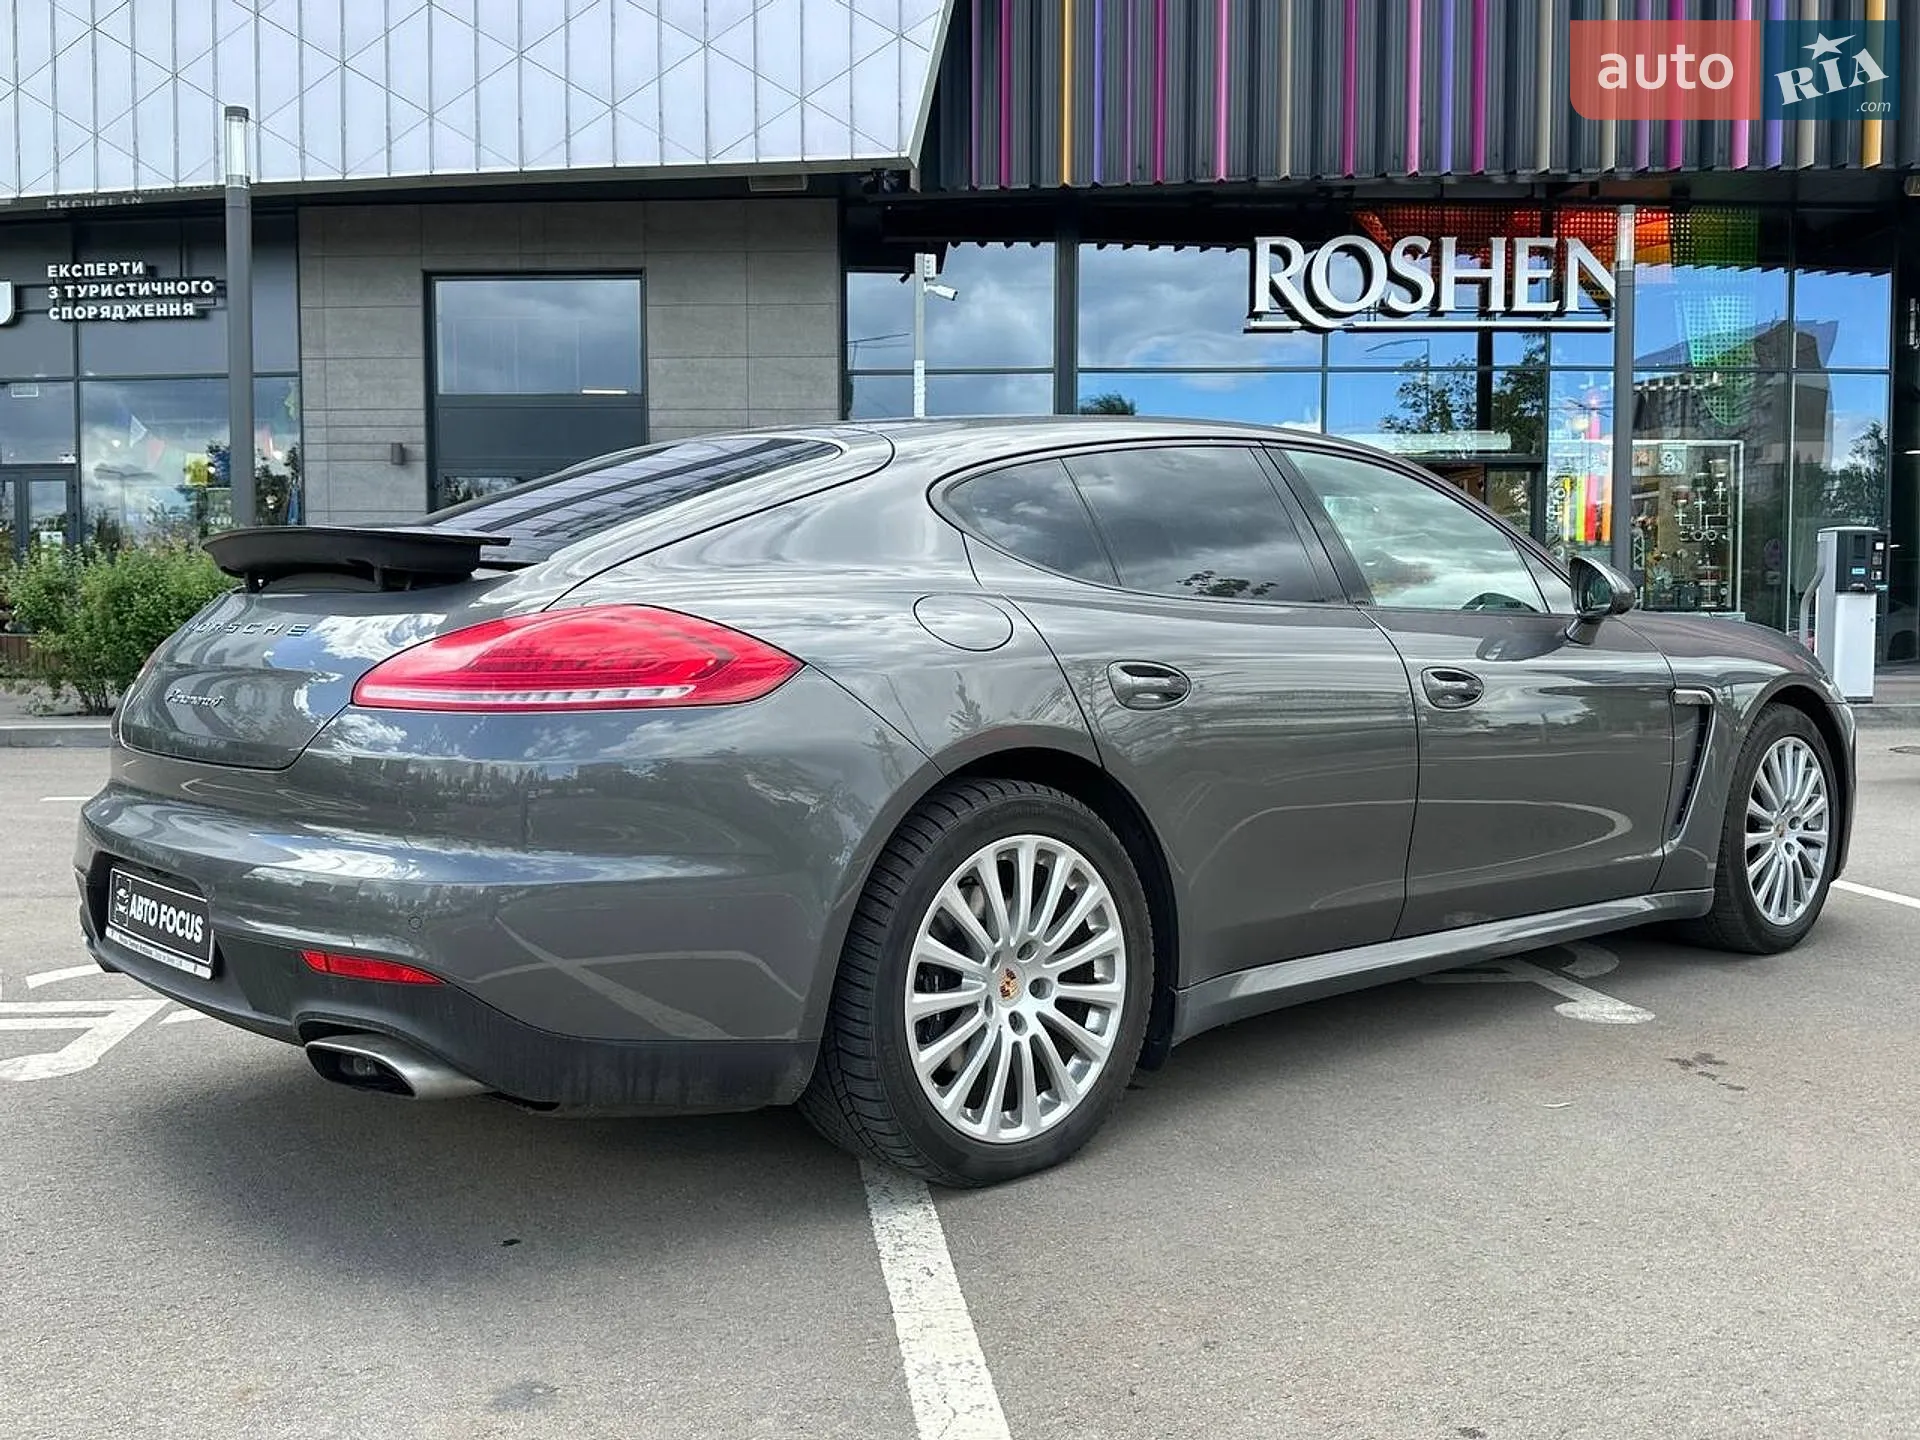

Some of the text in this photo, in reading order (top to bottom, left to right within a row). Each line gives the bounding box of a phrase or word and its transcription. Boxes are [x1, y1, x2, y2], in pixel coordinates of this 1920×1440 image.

[47, 261, 144, 278] ЕКСПЕРТИ
[48, 280, 214, 300] З ТУРИСТИЧНОГО
[1253, 234, 1615, 328] ROSHEN
[49, 302, 195, 321] СПОРЯДЖЕННЯ
[158, 903, 204, 943] FOCUS
